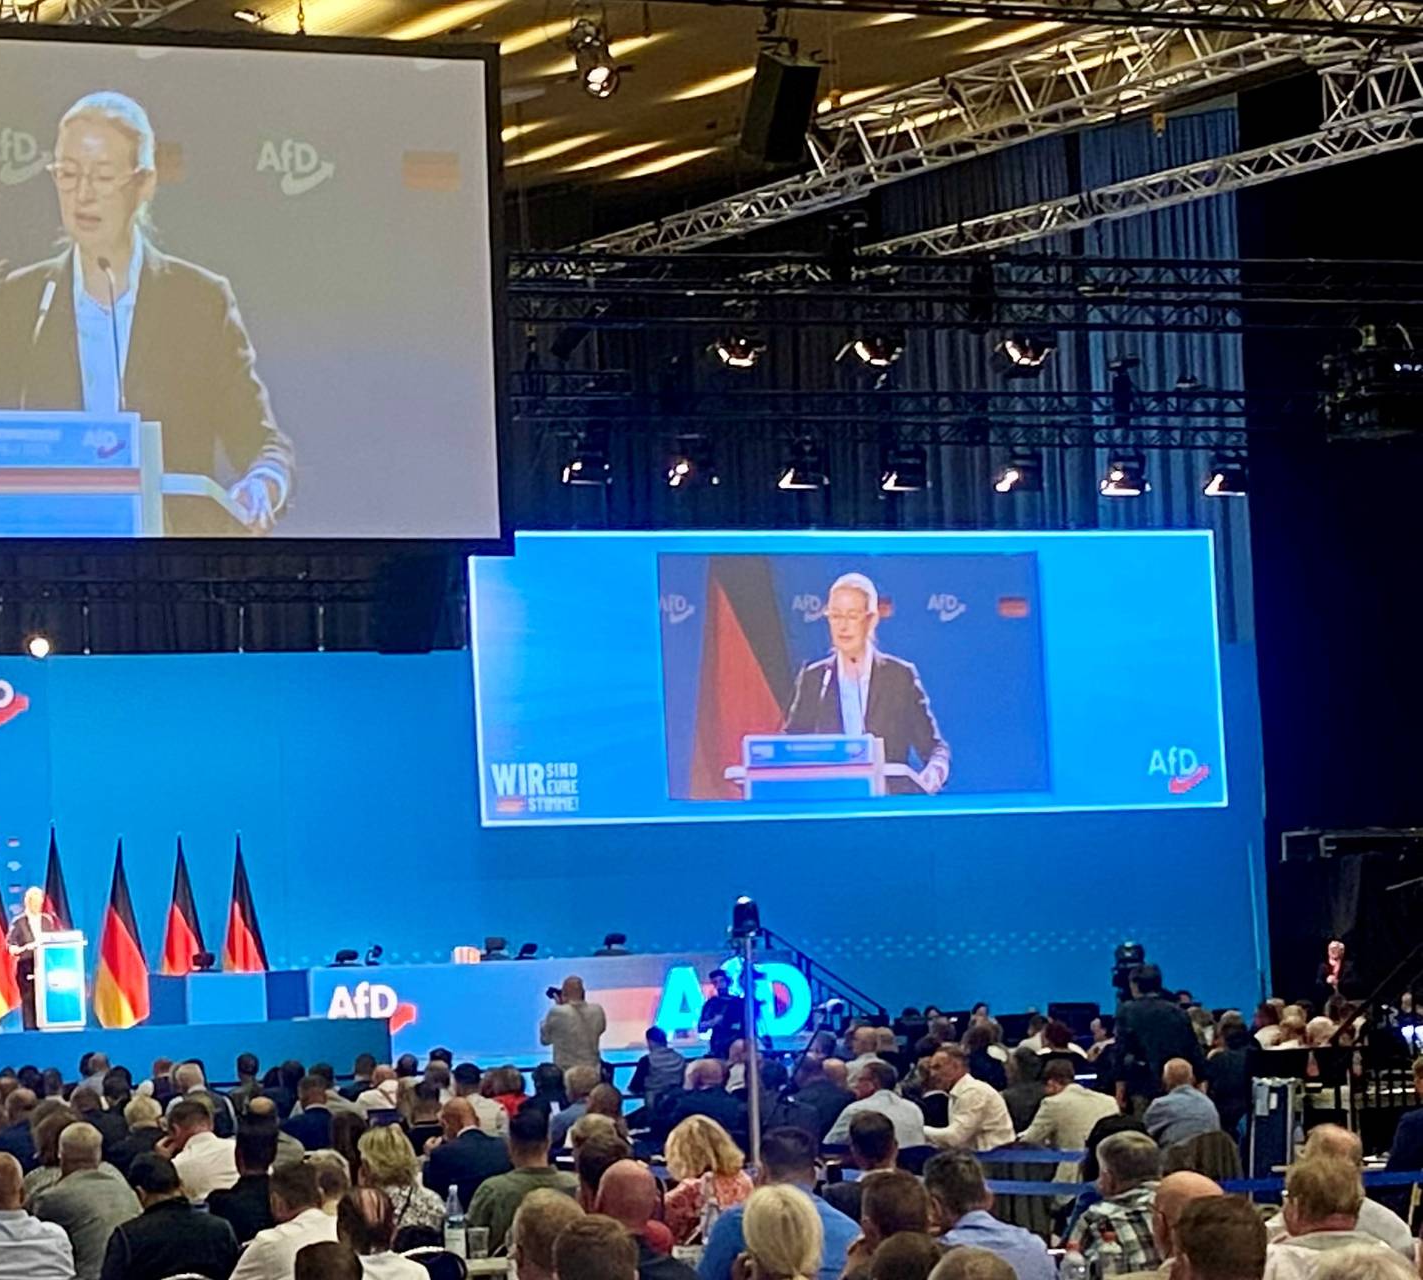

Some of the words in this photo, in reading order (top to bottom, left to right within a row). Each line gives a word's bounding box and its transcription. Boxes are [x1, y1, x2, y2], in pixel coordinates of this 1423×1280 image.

[257, 139, 318, 173] AfD
[1147, 746, 1198, 776] AfD
[490, 762, 546, 796] WIR
[545, 762, 578, 778] SIND
[327, 981, 398, 1019] AfD
